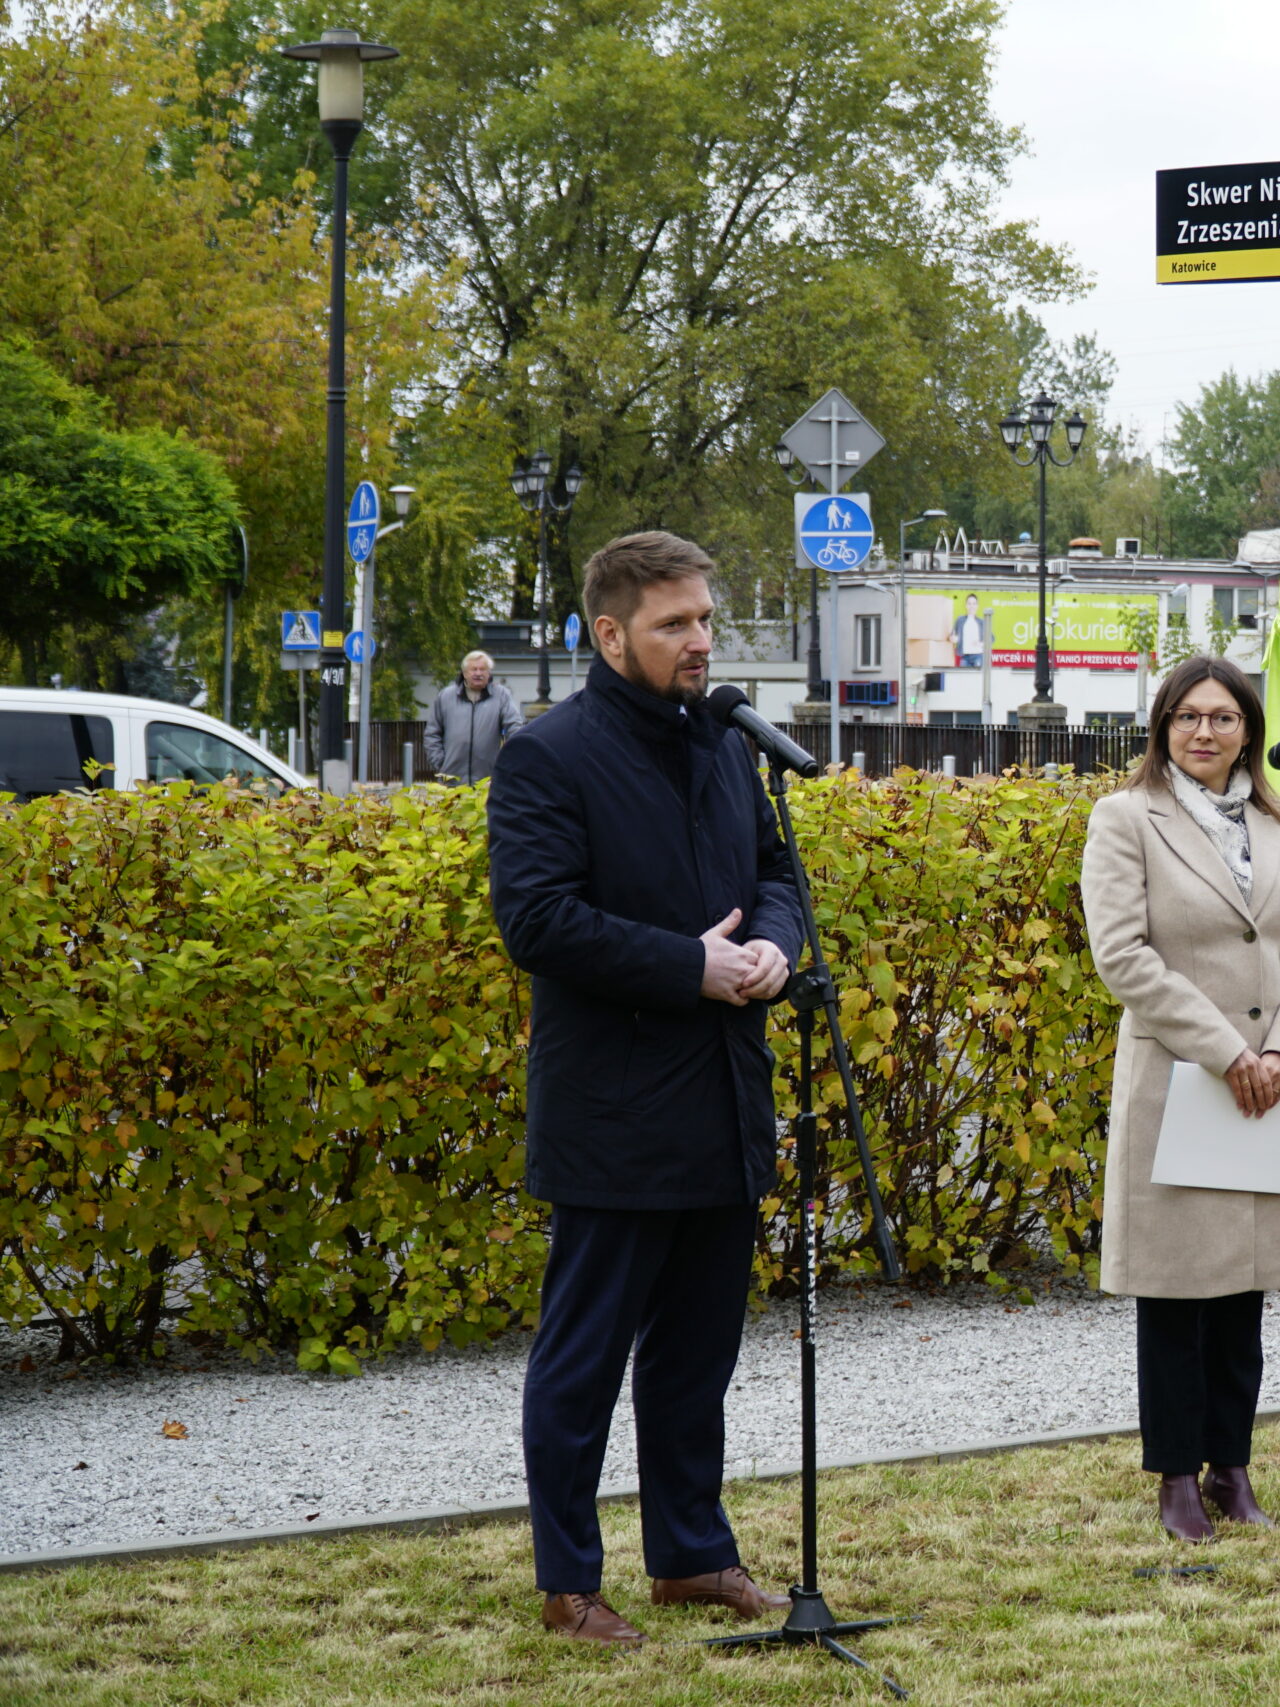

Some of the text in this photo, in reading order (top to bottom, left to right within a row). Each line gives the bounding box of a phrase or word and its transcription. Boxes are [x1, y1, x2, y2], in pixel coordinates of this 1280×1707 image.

[1186, 181, 1252, 207] Skwer
[1171, 259, 1217, 274] Katowice
[991, 651, 1021, 663] WYCEŃ
[1056, 653, 1081, 664] TANIO
[1082, 654, 1122, 666] PRZESYŁKĘ
